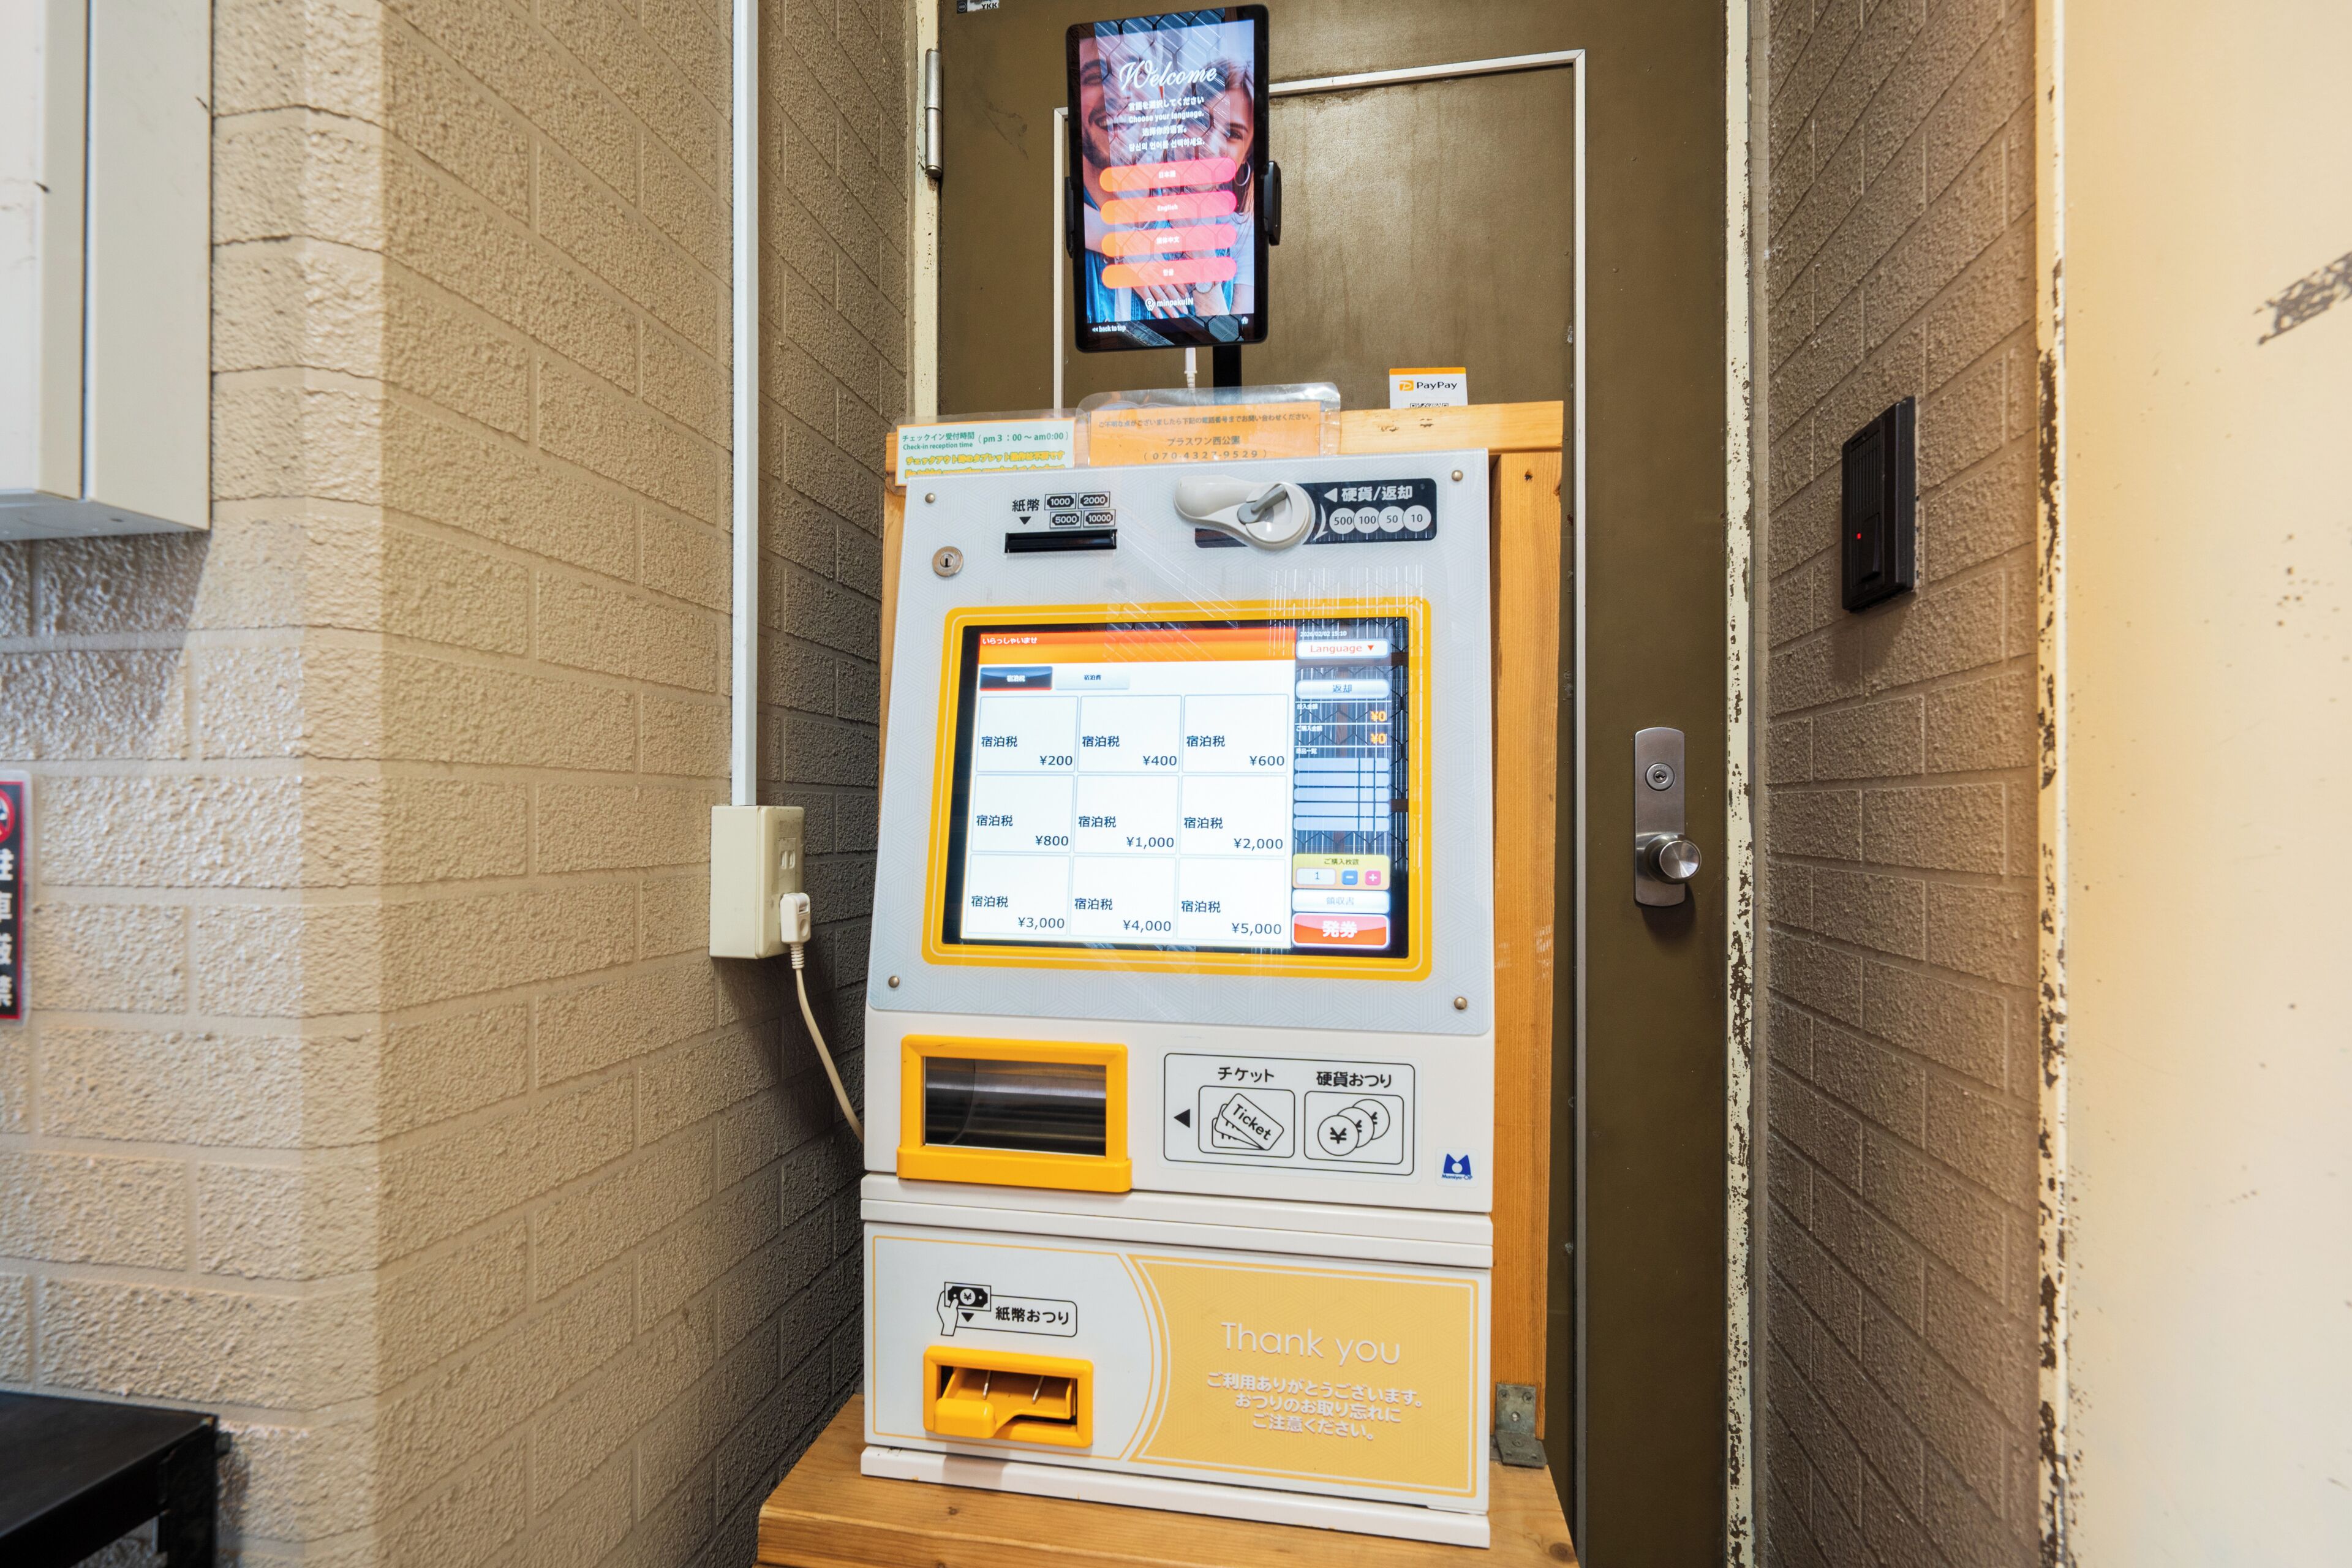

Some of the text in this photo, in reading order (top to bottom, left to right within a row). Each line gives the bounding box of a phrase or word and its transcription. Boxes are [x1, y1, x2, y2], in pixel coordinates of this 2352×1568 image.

[1120, 59, 1217, 91] Welcome
[1172, 110, 1205, 120] language.
[1157, 203, 1178, 212] English
[1156, 297, 1194, 307] minpakuIN
[1117, 324, 1126, 333] top
[1417, 382, 1457, 390] PayPay
[902, 431, 975, 442] チェックイン受付時間
[1167, 435, 1240, 447] プラスワン西公園
[1341, 486, 1413, 502] 硬貨/返却
[1012, 499, 1040, 512] 紙幣
[1050, 496, 1106, 506] 1000 2000
[1055, 514, 1111, 524] 5000 10000
[1334, 514, 1423, 526] 500 100 50 10
[982, 636, 1038, 645] いらっしゃいませ
[1310, 644, 1363, 655] Language
[1332, 684, 1352, 693] 返却
[1371, 710, 1387, 722] ¥0
[981, 736, 1017, 747] 宿泊税
[1082, 736, 1120, 747] 宿泊税
[1186, 735, 1226, 747] 宿泊税
[1371, 733, 1387, 745] ¥0
[1040, 756, 1073, 766] ¥200
[1143, 756, 1177, 766] ¥400
[1250, 756, 1285, 766] ¥600
[976, 815, 1013, 827] 宿泊税
[1078, 816, 1117, 828] 宿泊税
[1184, 817, 1223, 829] 宿泊税
[1035, 835, 1069, 846] ¥800
[1126, 837, 1174, 850] ¥1,000
[1234, 838, 1283, 851] ¥2,000
[1315, 872, 1320, 880] 1
[971, 895, 1009, 908] 宿泊税
[1074, 898, 1113, 911] 宿泊税
[1181, 900, 1221, 913] 宿泊税
[1018, 917, 1065, 930] ¥3,000
[1123, 919, 1171, 933] ¥4,000
[1232, 922, 1281, 936] ¥5,000
[1322, 920, 1358, 938] 発券
[1218, 1067, 1275, 1083] チケット
[1316, 1071, 1392, 1088] 硬貨おつり
[1233, 1104, 1272, 1140] Ticket
[995, 1306, 1069, 1325] 紙幣おつり
[1221, 1322, 1401, 1366] Thank you
[1207, 1371, 1423, 1408] ご利用ありがとうございます。
[1235, 1393, 1401, 1423] おつりのお取り忘れに
[1253, 1413, 1374, 1441] ご注意ください。
